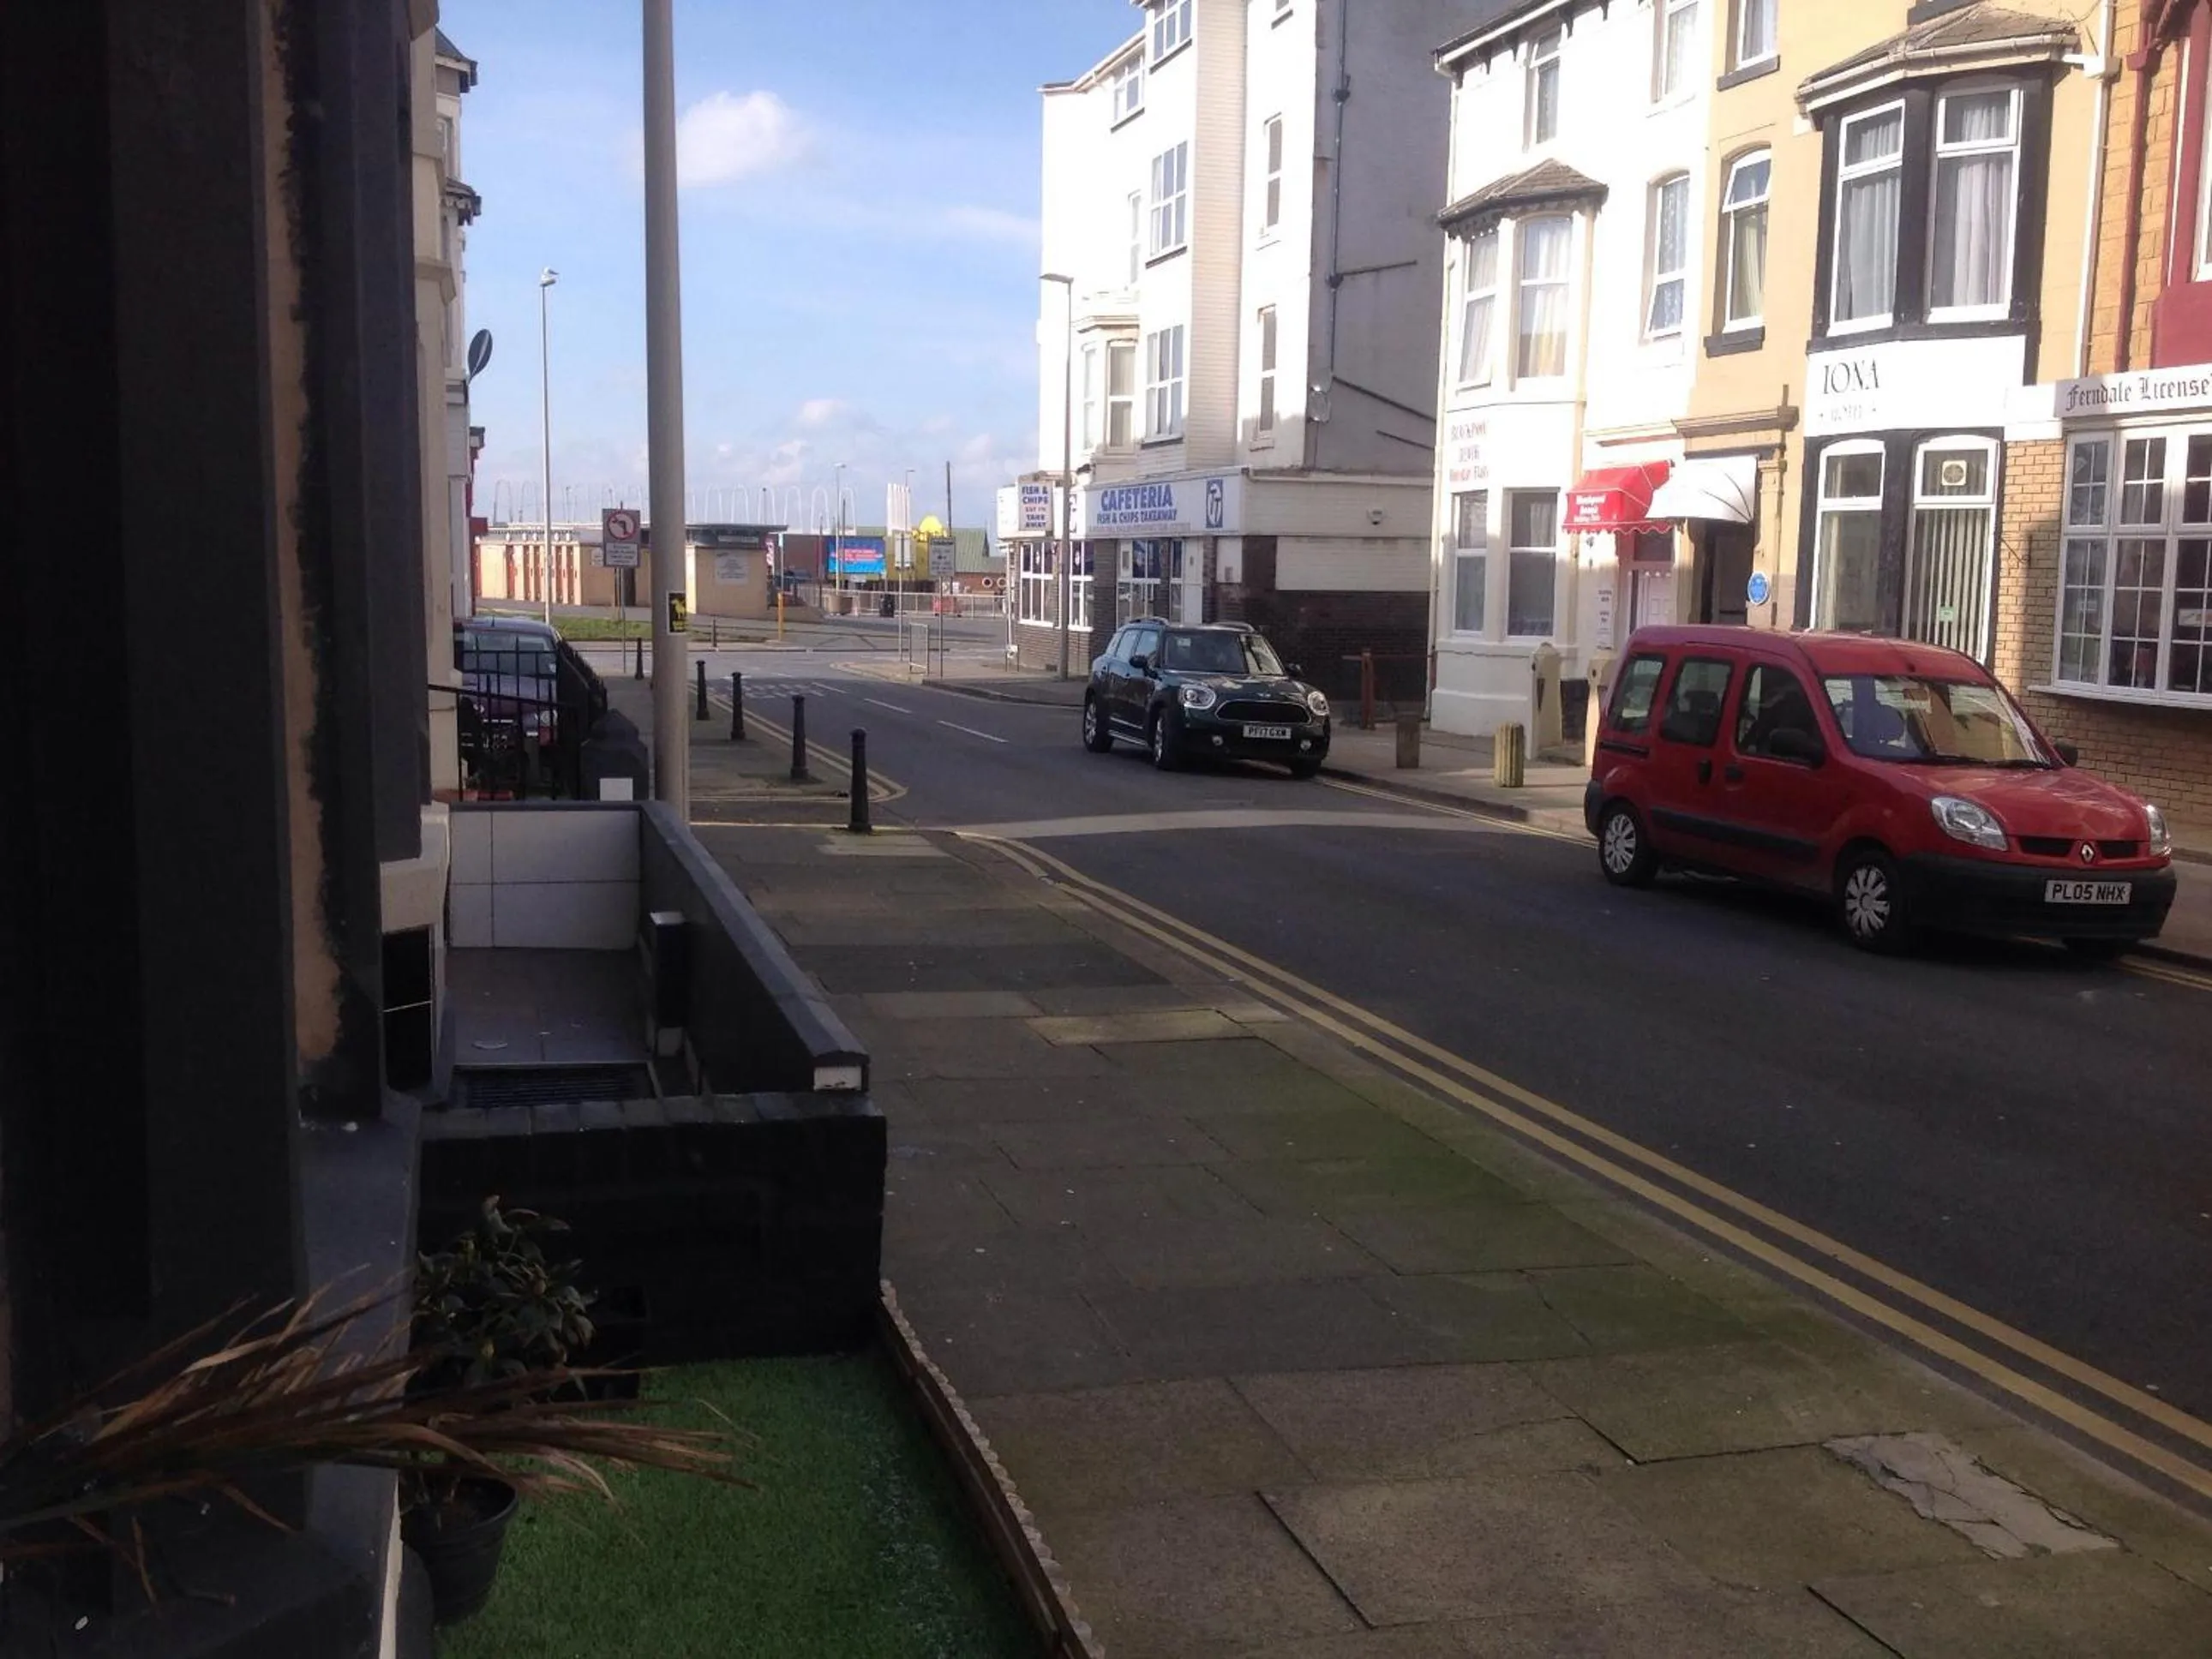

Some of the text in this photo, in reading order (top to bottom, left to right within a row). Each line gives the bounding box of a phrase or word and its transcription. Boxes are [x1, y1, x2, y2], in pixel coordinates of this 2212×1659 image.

[1823, 358, 1879, 394] IONA
[2065, 381, 2132, 411] Ferndale
[1022, 486, 1039, 494] FISH
[1100, 483, 1173, 512] CAFETERIA
[1022, 496, 1048, 505] CHIPS
[1097, 512, 1111, 524] FISH
[1118, 511, 1139, 524] CHIPS
[1140, 508, 1178, 523] TAKEAWAY
[2052, 883, 2125, 901] PL05 NHX
